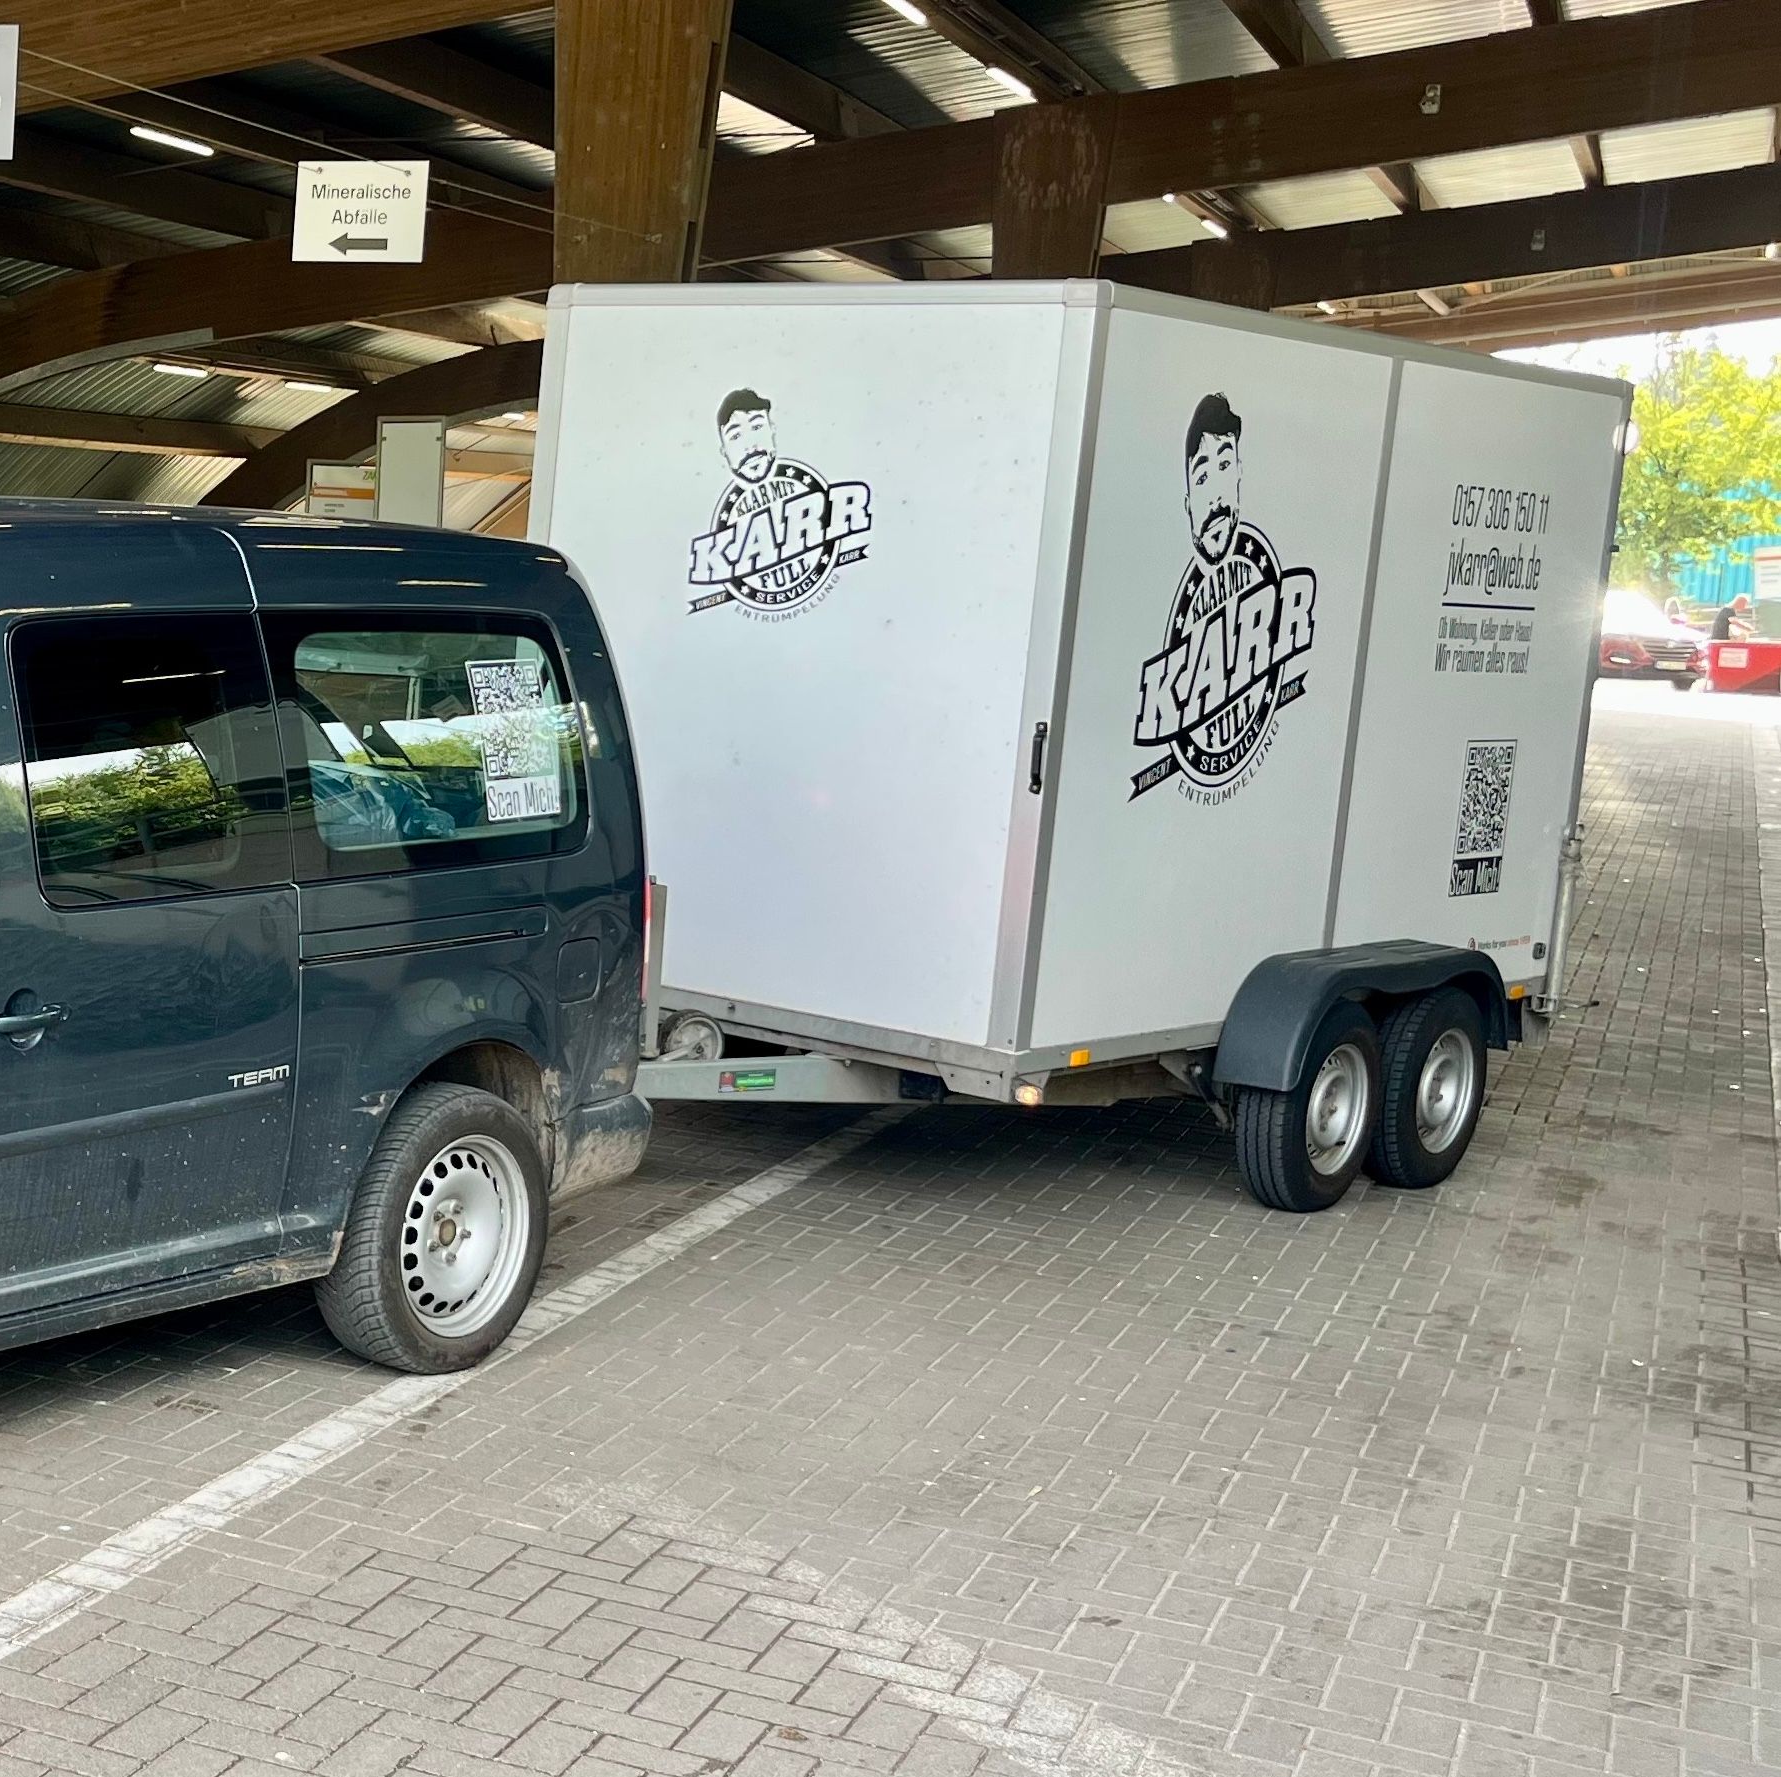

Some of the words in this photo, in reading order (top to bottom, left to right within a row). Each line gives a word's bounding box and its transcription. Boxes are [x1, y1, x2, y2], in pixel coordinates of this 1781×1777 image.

[311, 184, 411, 201] Mineralische
[331, 208, 388, 226] Abfälle
[1452, 484, 1485, 527] 0157
[1485, 488, 1512, 530] 306
[1514, 491, 1536, 533] 150
[1538, 494, 1550, 535] 11
[688, 481, 873, 585] KARR
[757, 557, 811, 589] FULL
[1442, 537, 1541, 597] jvkarr@web.de
[755, 570, 821, 605] SERVICE
[1133, 567, 1317, 746] KARR
[1434, 642, 1451, 673] Wir
[1451, 644, 1485, 673] räumen
[1485, 641, 1506, 674] alles
[1506, 645, 1530, 674] raus!
[1279, 680, 1301, 703] KARR
[1205, 693, 1255, 749] FULL
[1199, 713, 1263, 774] SERVICE
[1137, 757, 1173, 791] VINCENT
[487, 785, 519, 819] Scan
[524, 775, 560, 814] Mich!
[1449, 863, 1475, 896] Scan
[1474, 857, 1502, 894] Mich!
[227, 1064, 290, 1088] TEAM
